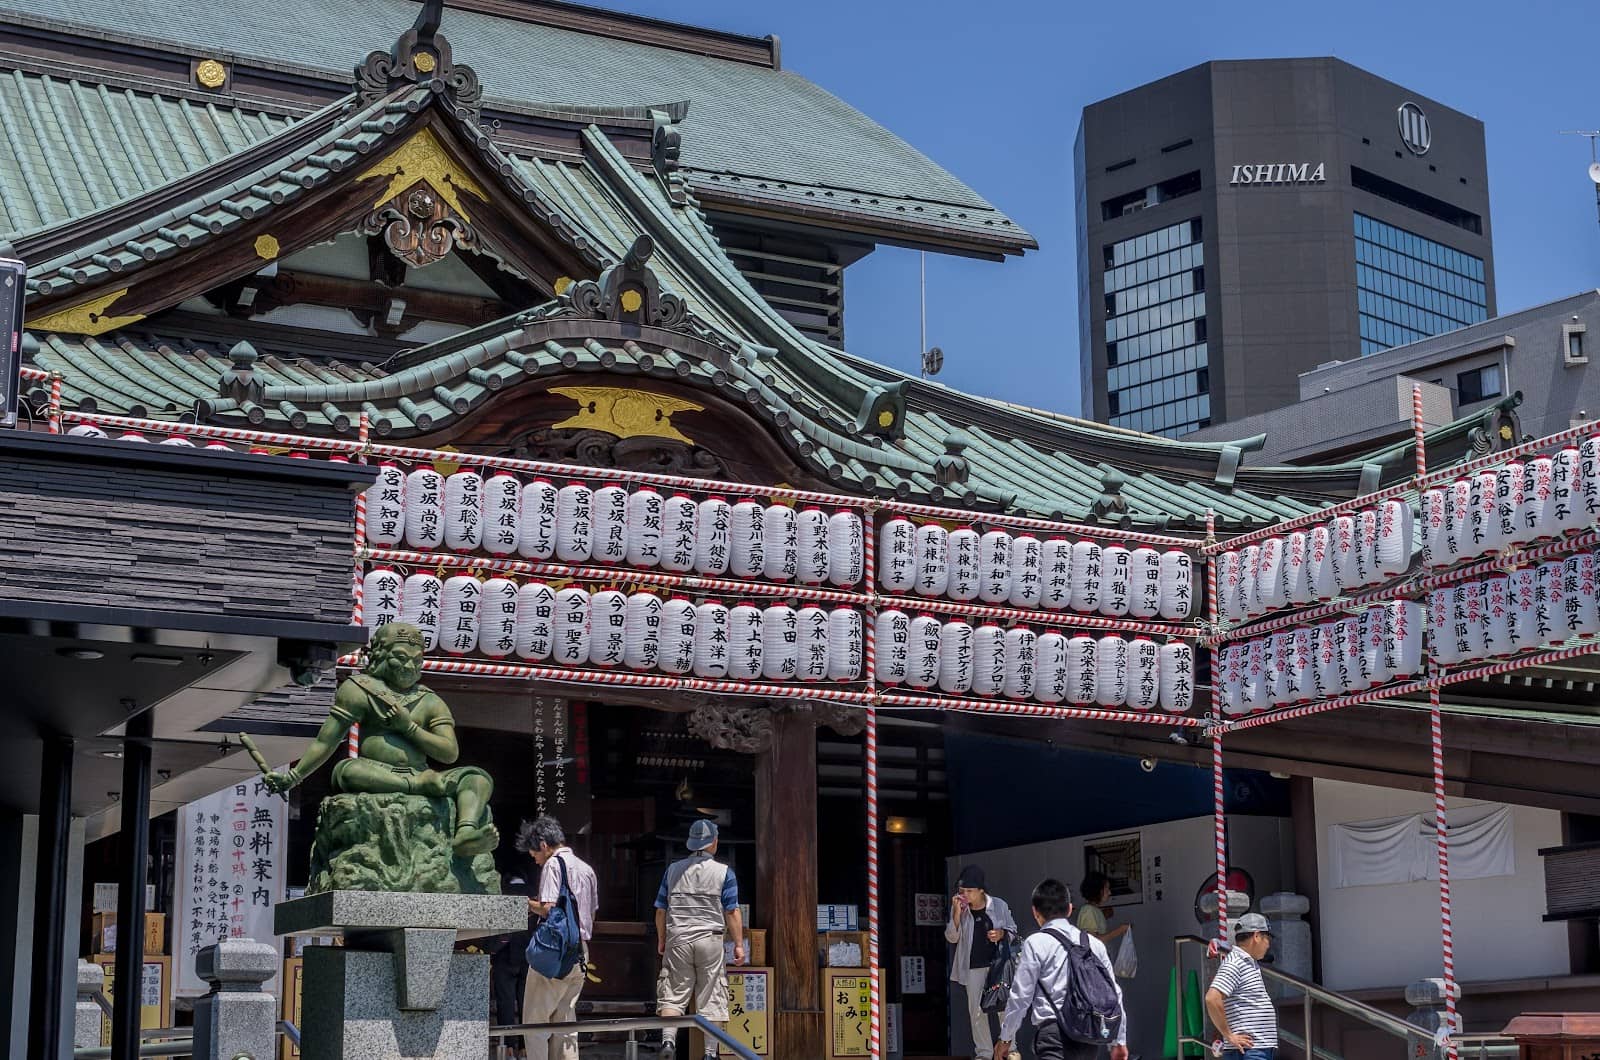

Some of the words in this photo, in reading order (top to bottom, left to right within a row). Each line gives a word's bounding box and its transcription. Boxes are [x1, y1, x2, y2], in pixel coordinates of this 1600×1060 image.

[1230, 162, 1326, 184] ISHIMA
[380, 470, 402, 538] 宮坂知里
[419, 474, 439, 541] 宮坂尚実
[458, 475, 480, 544] 宮坂聡美
[497, 479, 518, 545] 宮坂佳治
[535, 487, 557, 552] 宮坂とし子
[1552, 453, 1571, 521] 北村和子
[571, 488, 591, 554] 宮坂信次
[605, 490, 626, 557] 宮坂良弥
[641, 497, 661, 559] 宮坂一江
[674, 501, 696, 566] 宮坂光弥
[708, 504, 729, 571] 長谷川健治
[747, 506, 765, 574] 長谷川三知子
[810, 513, 829, 578] 小野木純子
[1109, 551, 1131, 610] 百川雅子
[1142, 553, 1160, 612] 福田珠江
[1174, 555, 1191, 614] 石川栄司
[1564, 557, 1583, 631] 須藤勝子
[497, 582, 518, 652] 今田有香
[566, 593, 586, 660] 今田聖乃
[604, 594, 626, 663] 今田景久
[640, 598, 662, 666] 今田三映子
[675, 606, 697, 672] 今田洋輔
[708, 609, 728, 671] 宮本洋一
[745, 612, 763, 675] 井上和幸
[806, 611, 827, 676] 今木繁行
[920, 622, 941, 684] 飯田秀子
[1015, 633, 1036, 697] 伊藤麻里子
[1052, 637, 1070, 698] 小川貴史
[1138, 643, 1156, 707] 細野美智子
[1334, 622, 1352, 688] 田中まち子
[249, 806, 274, 908] 無料案内
